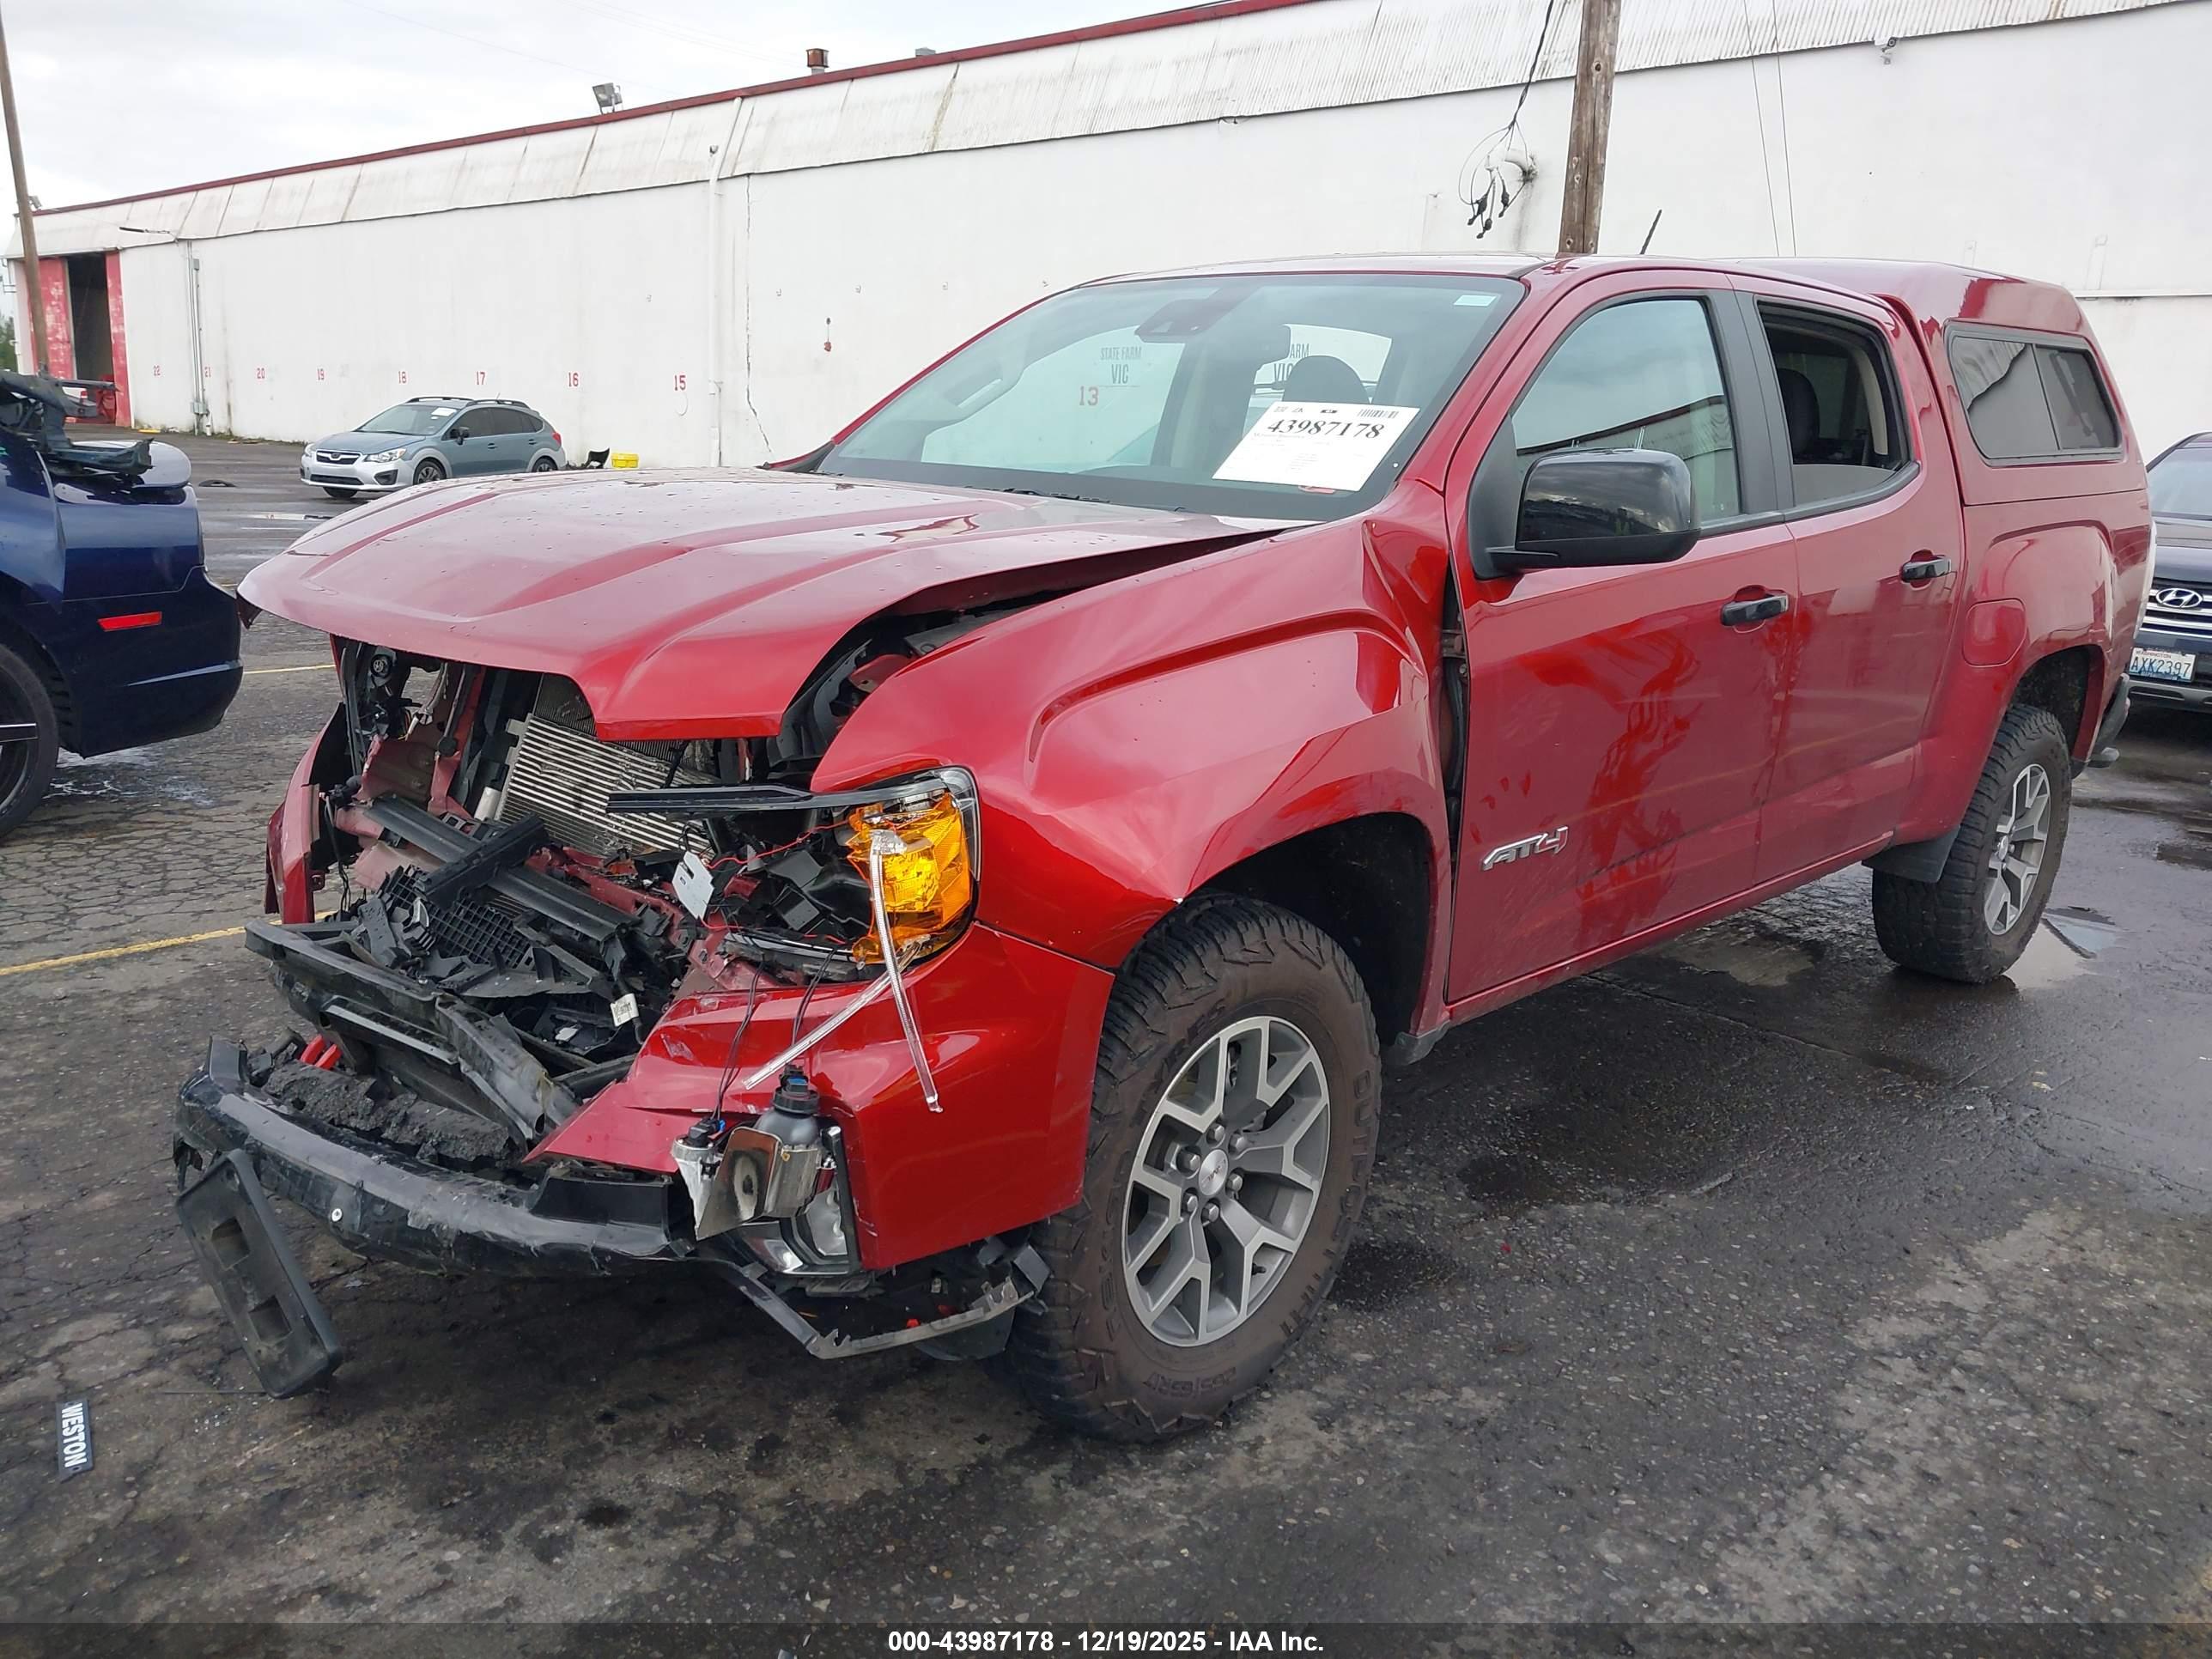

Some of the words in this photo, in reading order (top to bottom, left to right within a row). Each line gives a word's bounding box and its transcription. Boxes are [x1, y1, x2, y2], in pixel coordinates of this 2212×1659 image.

[1100, 347, 1120, 361] STATE
[1121, 345, 1142, 361] FARM
[1290, 343, 1310, 358] ARM
[257, 368, 265, 380] 20
[317, 368, 325, 380] 19
[398, 371, 407, 384] 18
[476, 371, 486, 385] 17
[568, 372, 579, 386] 16
[1111, 363, 1129, 384] VIC
[674, 375, 686, 391] 15
[1079, 386, 1099, 406] 13
[1267, 419, 1385, 439] 43987178
[2130, 656, 2191, 678] AXK2397
[1482, 825, 1569, 872] AT4
[61, 1402, 88, 1468] WESTON
